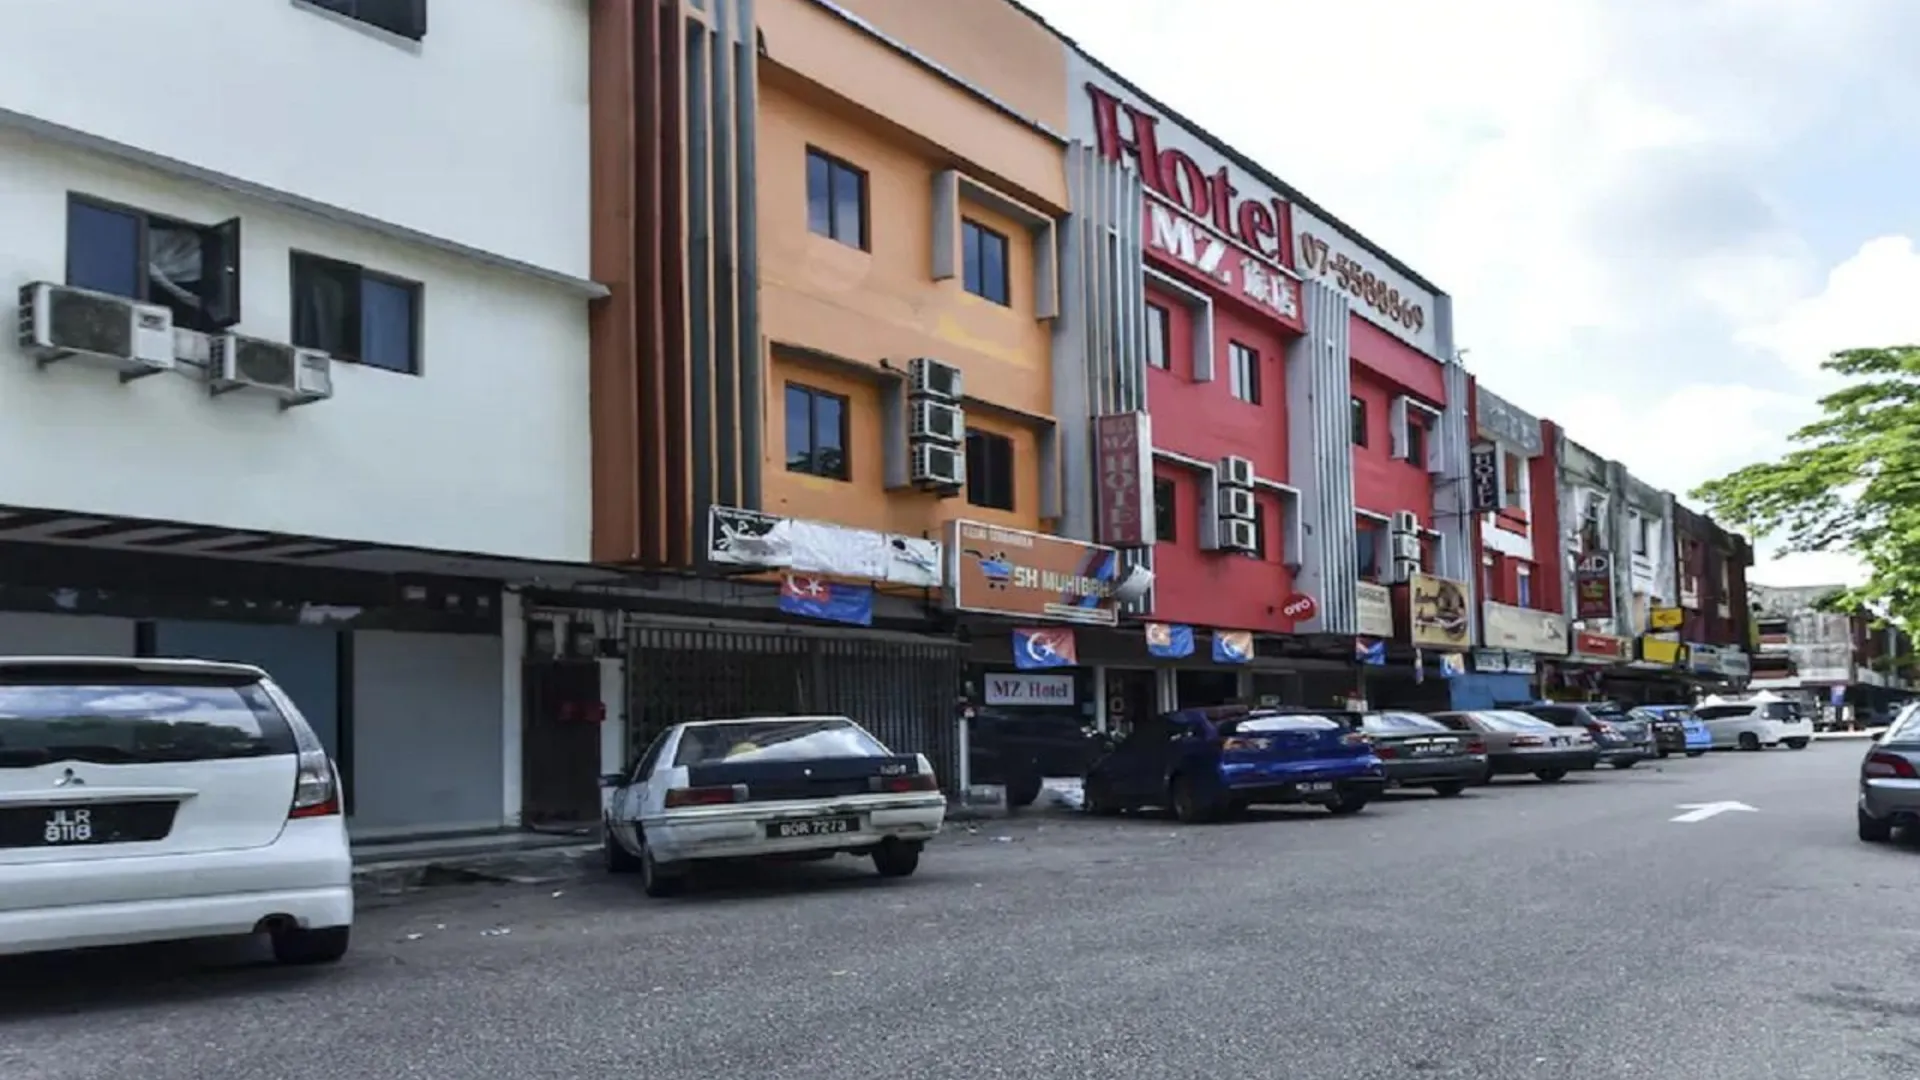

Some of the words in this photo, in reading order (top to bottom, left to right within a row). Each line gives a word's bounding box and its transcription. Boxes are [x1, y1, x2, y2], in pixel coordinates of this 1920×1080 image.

[1085, 82, 1295, 271] Hotel
[1148, 200, 1231, 285] MZ
[1474, 455, 1495, 507] HOTEL
[1105, 452, 1136, 542] HOTEL
[1578, 556, 1608, 573] 4D
[1014, 565, 1038, 589] SH
[1283, 598, 1311, 617] OYO
[993, 680, 1022, 698] MZ
[1029, 682, 1068, 698] Hotel
[46, 809, 91, 825] JLR
[45, 825, 92, 842] 8118
